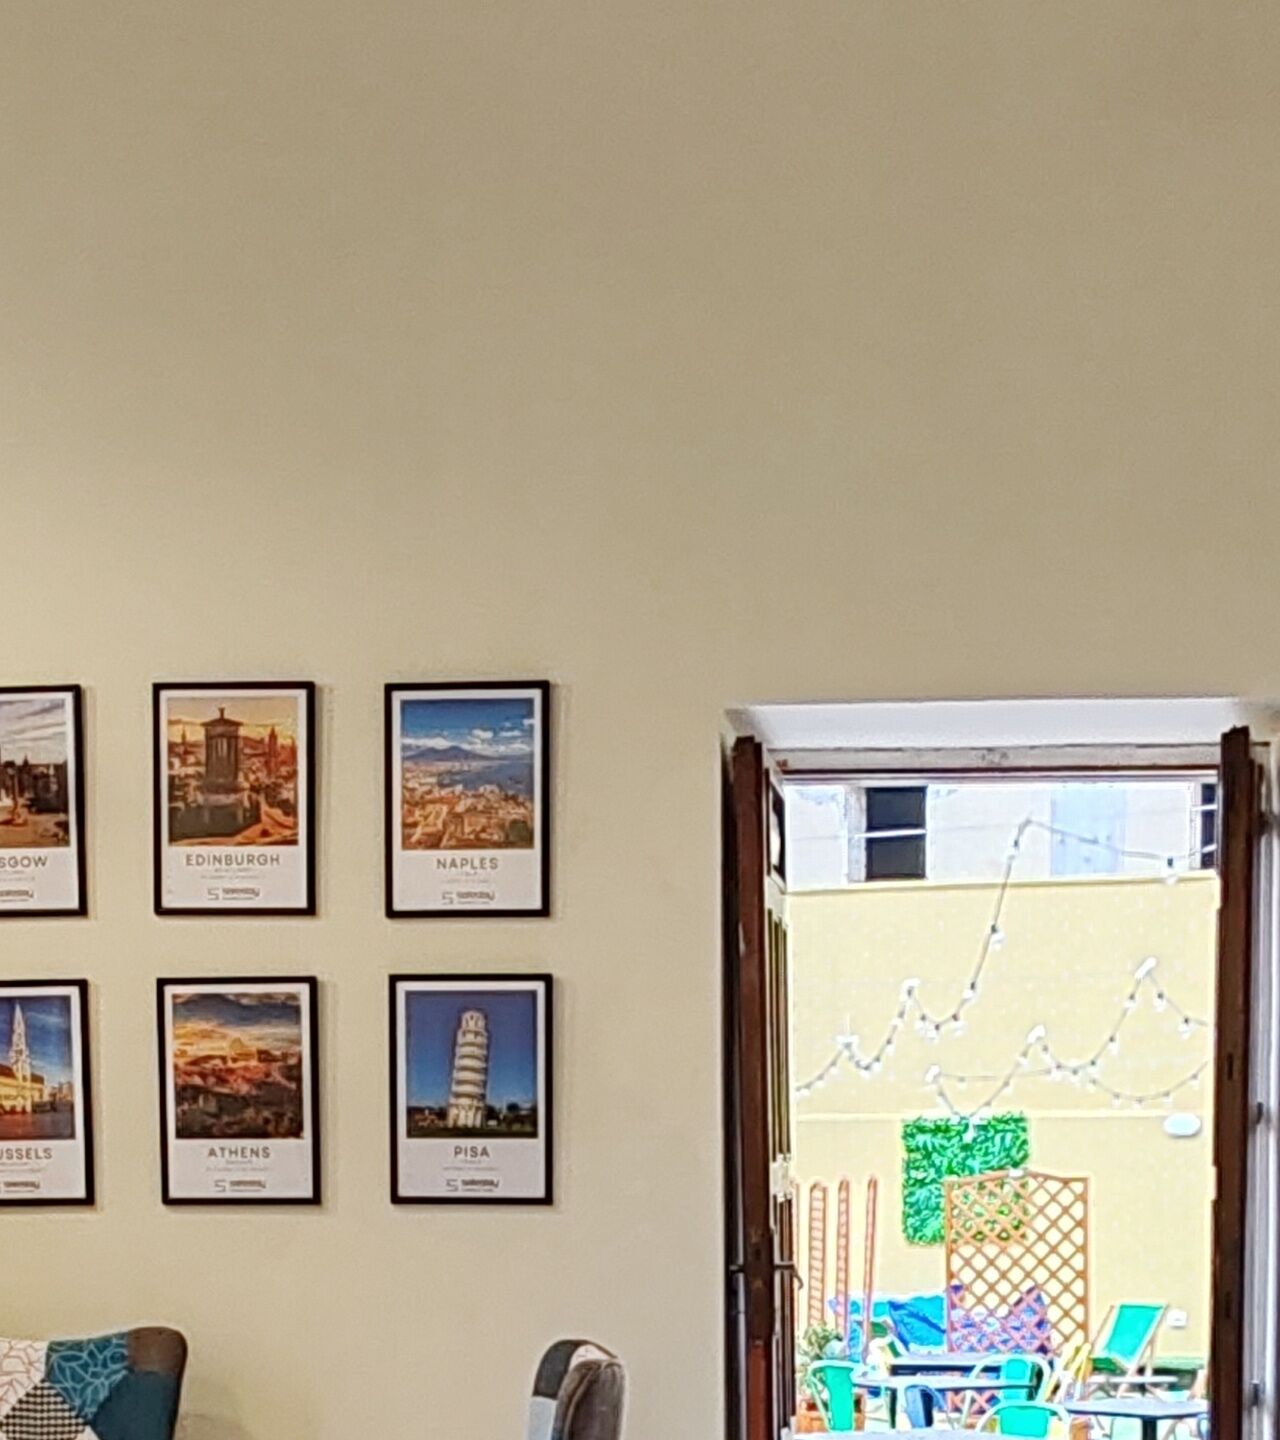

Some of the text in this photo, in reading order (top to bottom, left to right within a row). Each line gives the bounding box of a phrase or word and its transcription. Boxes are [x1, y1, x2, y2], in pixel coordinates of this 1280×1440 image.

[185, 854, 281, 866] EDINBURGH
[436, 857, 498, 870] NAPLES
[207, 1146, 271, 1159] ATHENS
[453, 1145, 490, 1158] PISA
